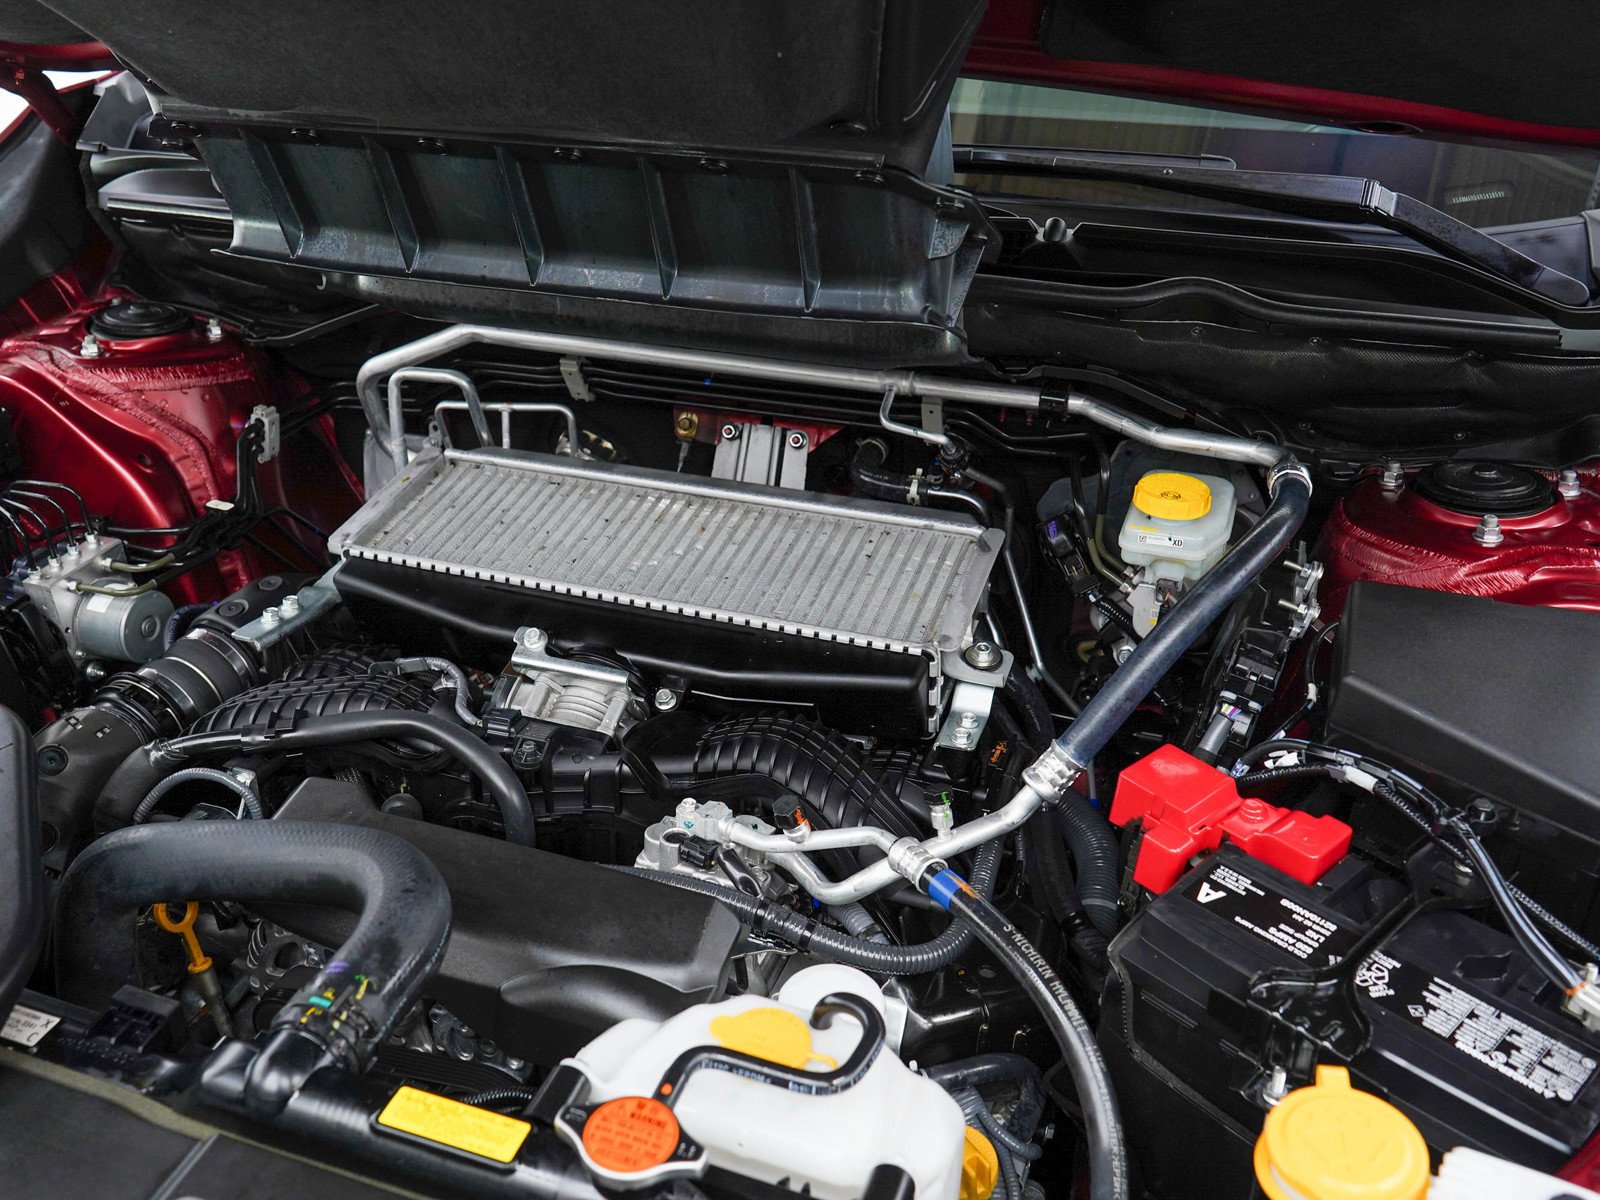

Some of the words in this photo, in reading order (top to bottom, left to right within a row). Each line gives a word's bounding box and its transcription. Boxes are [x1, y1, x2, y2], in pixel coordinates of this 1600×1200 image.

[1197, 882, 1227, 904] A
[1234, 916, 1255, 929] AMPS
[1253, 926, 1288, 948] CRANKING
[1268, 926, 1297, 944] AMPS
[1003, 923, 1055, 980] S-NICHIRIN
[1287, 945, 1308, 959] COLD
